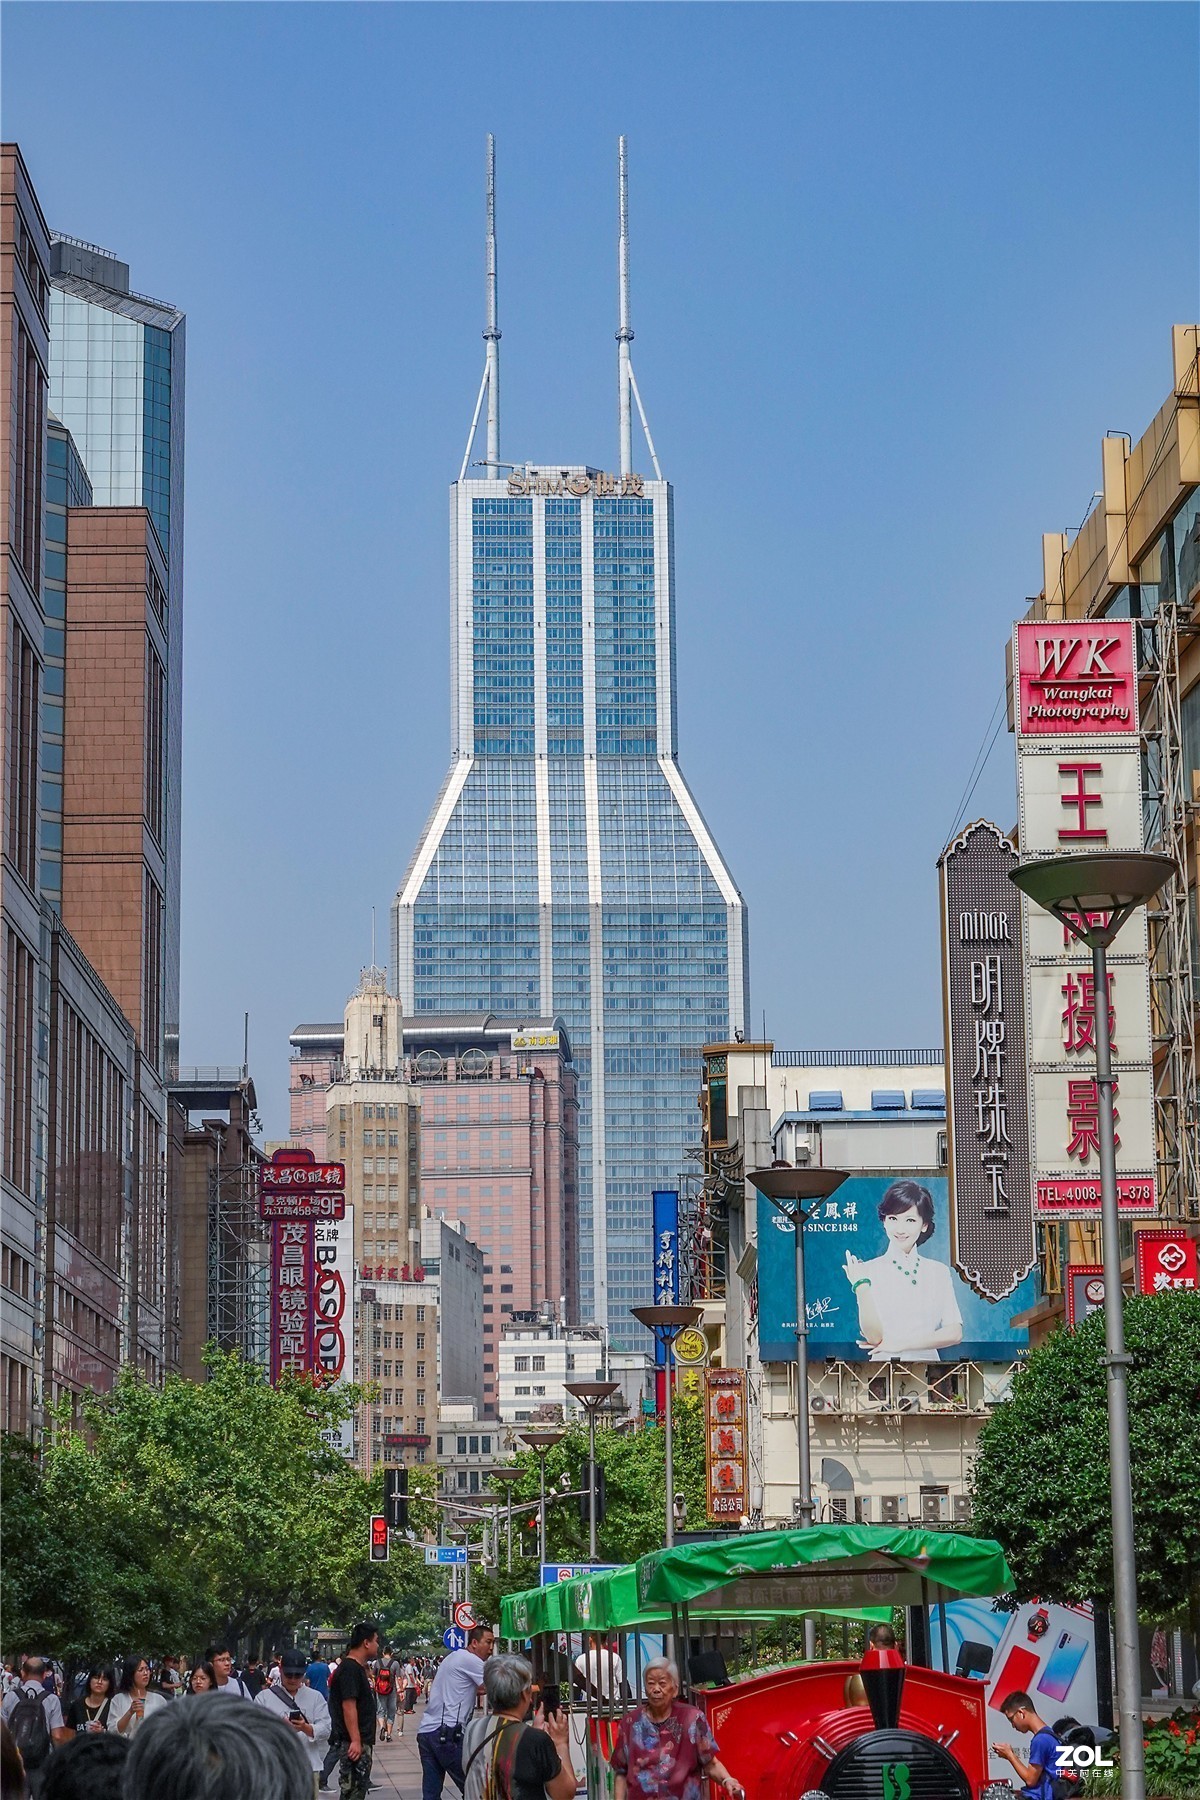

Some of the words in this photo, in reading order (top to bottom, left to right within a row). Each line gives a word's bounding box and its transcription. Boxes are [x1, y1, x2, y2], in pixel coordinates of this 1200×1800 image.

[1036, 637, 1119, 676] WK
[1043, 686, 1112, 701] Wangkai
[1027, 704, 1129, 719] Photography
[971, 955, 1011, 1211] 明牌珠宝
[307, 1167, 342, 1184] 眼镜
[320, 1196, 342, 1215] 9F
[315, 1229, 339, 1242] 名牌
[713, 1497, 743, 1512] 食品公司
